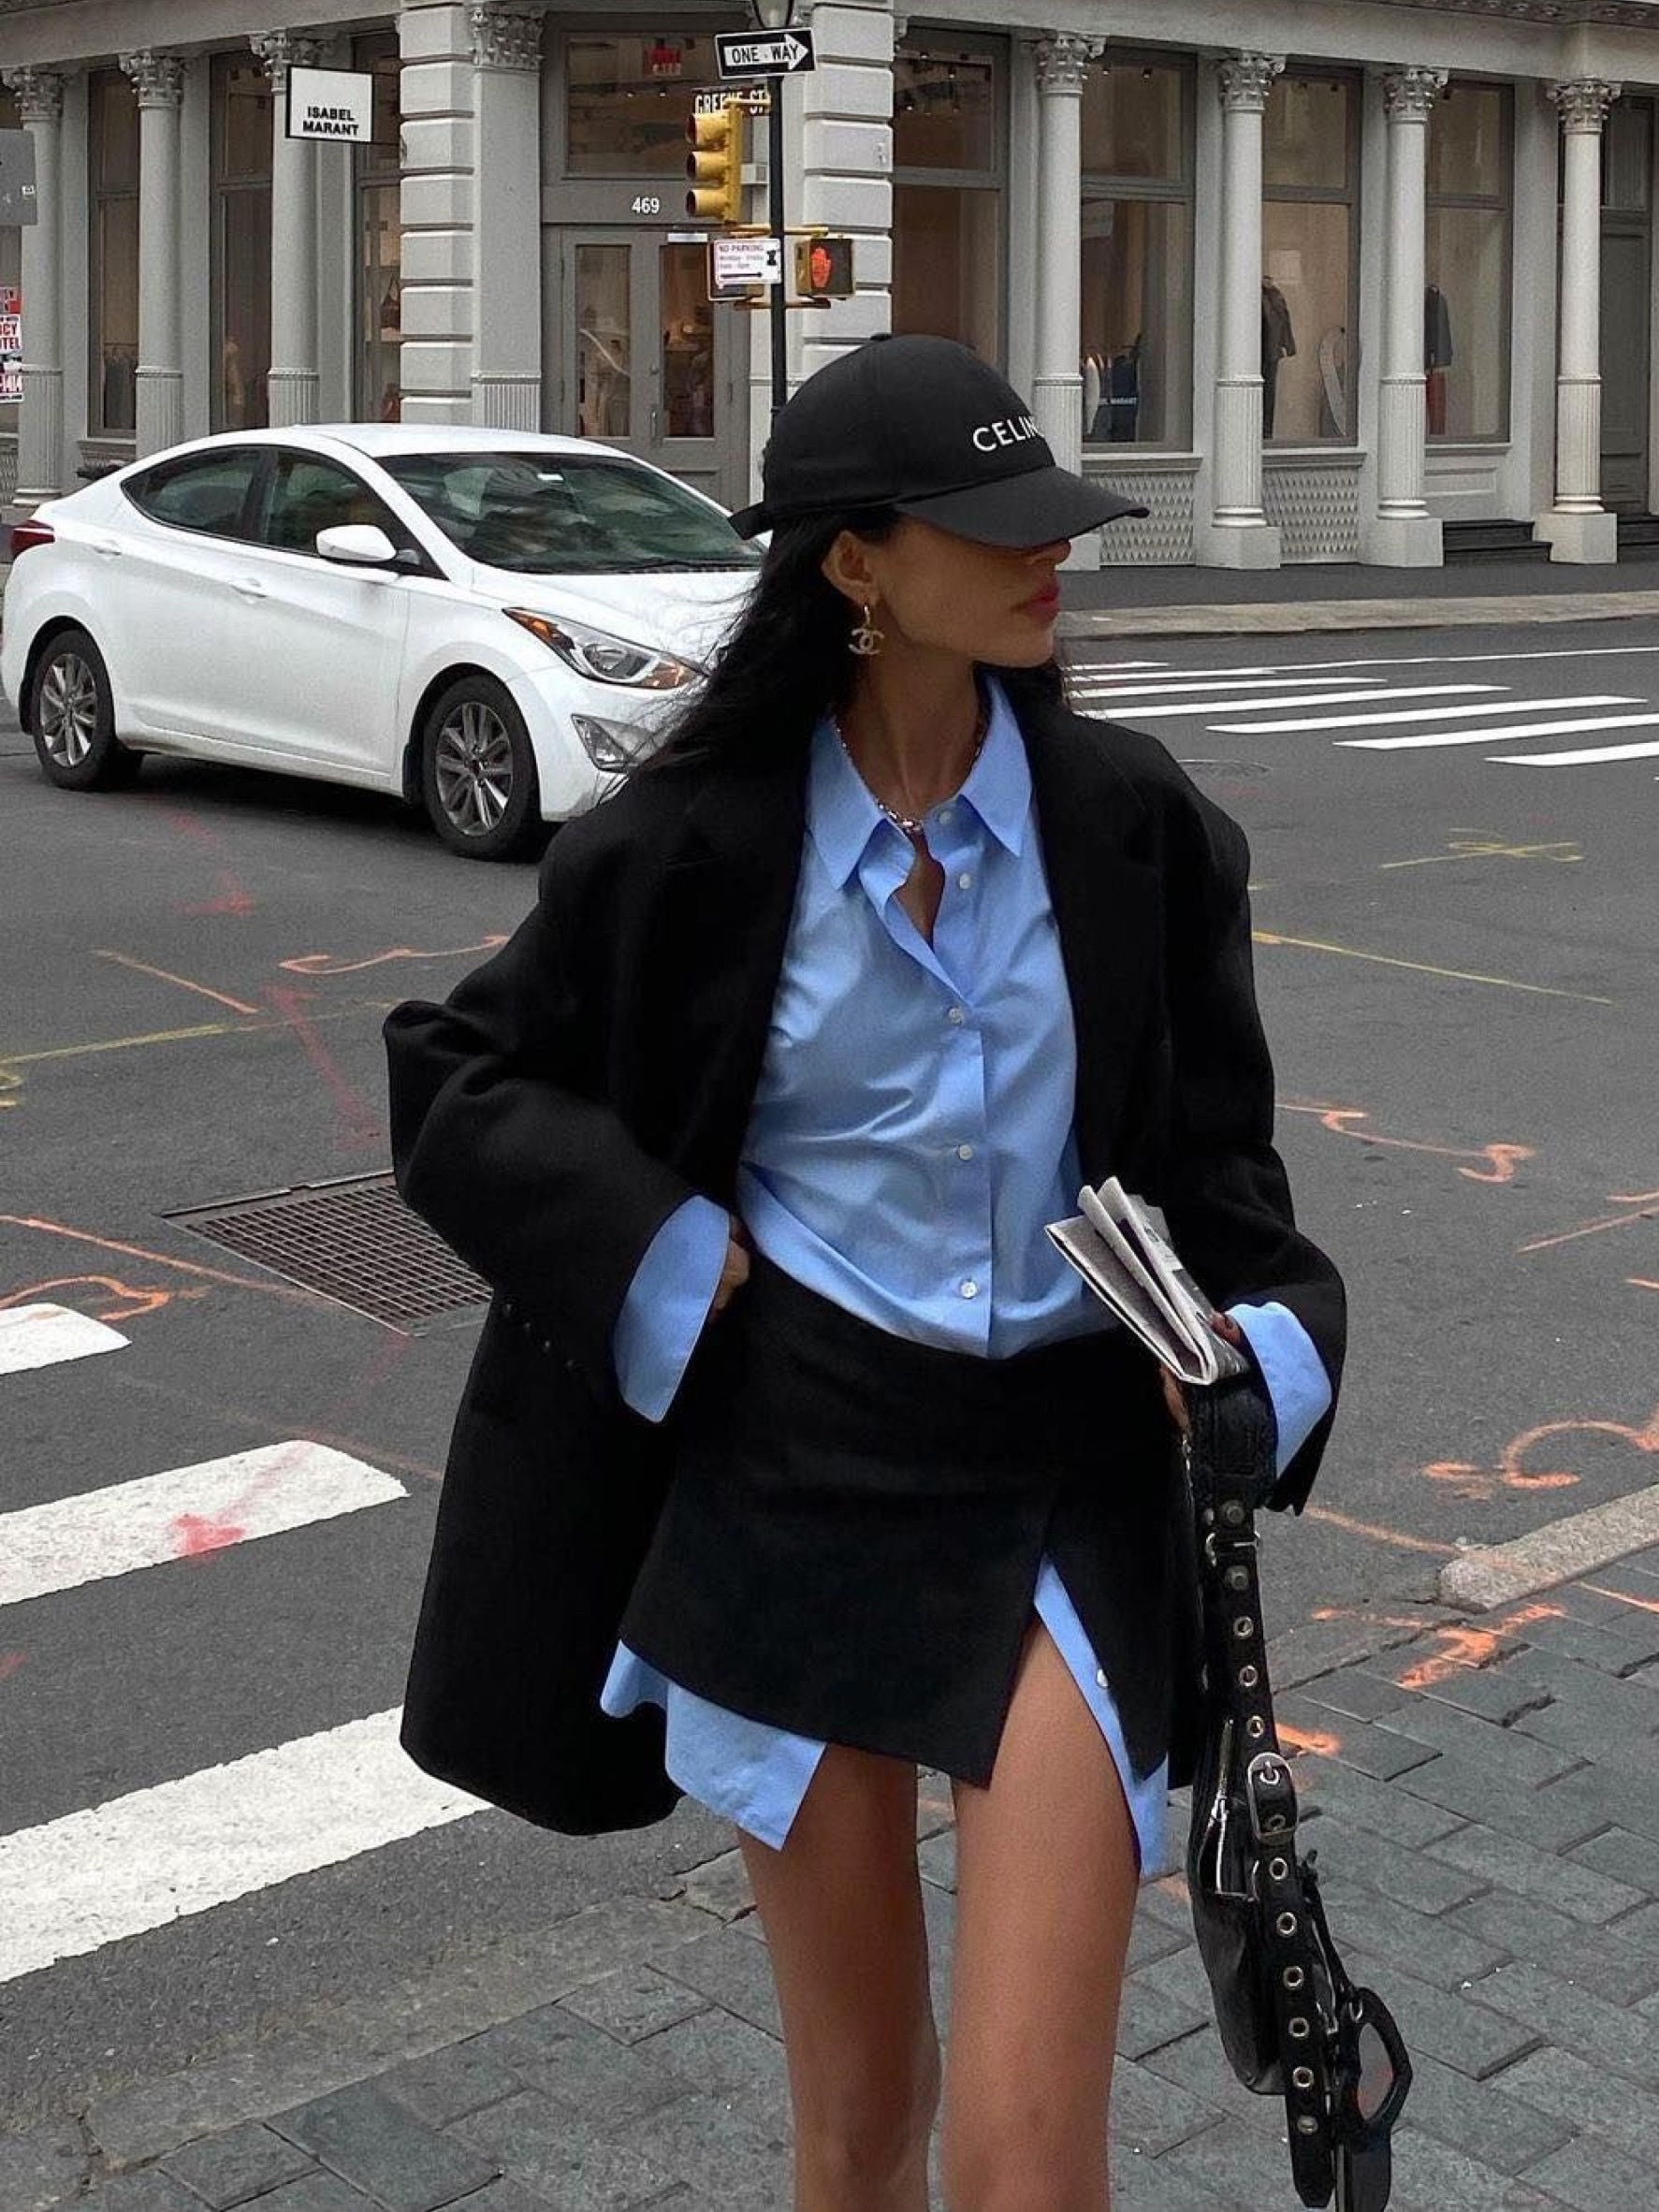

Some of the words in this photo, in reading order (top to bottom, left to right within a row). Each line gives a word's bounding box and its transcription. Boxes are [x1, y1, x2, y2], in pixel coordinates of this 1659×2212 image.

[732, 47, 760, 64] ONE
[770, 43, 798, 60] WAY
[307, 106, 355, 122] ISABEL
[302, 120, 359, 136] MARANT
[631, 196, 660, 214] 469
[973, 415, 1044, 452] CELIN
